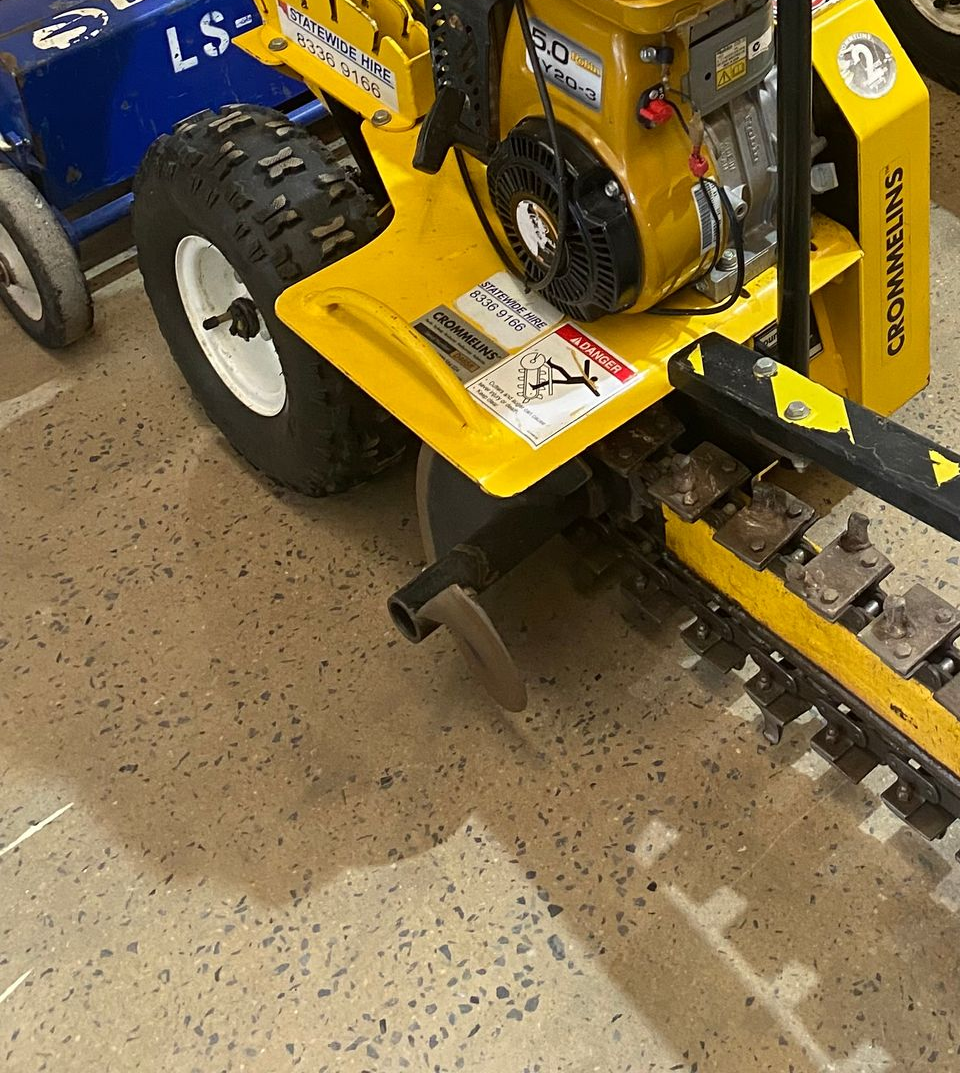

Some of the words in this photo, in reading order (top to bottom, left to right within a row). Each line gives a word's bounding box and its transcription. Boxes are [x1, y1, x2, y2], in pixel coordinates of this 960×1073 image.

[289, 7, 357, 62] STATEWIDE
[361, 53, 391, 84] HIRE
[297, 32, 336, 69] 8336
[341, 61, 381, 99] 9166
[532, 25, 569, 65] 5.0
[571, 51, 600, 77] Robin
[540, 59, 597, 102] Y20-3
[885, 167, 905, 357] CROMMELINS
[469, 289, 496, 312] 8336
[496, 308, 527, 333] 9166
[481, 280, 528, 315] STATEWIDE
[524, 309, 547, 330] HIRE
[432, 310, 500, 361] CROMMELINS
[579, 340, 625, 374] DANGER
